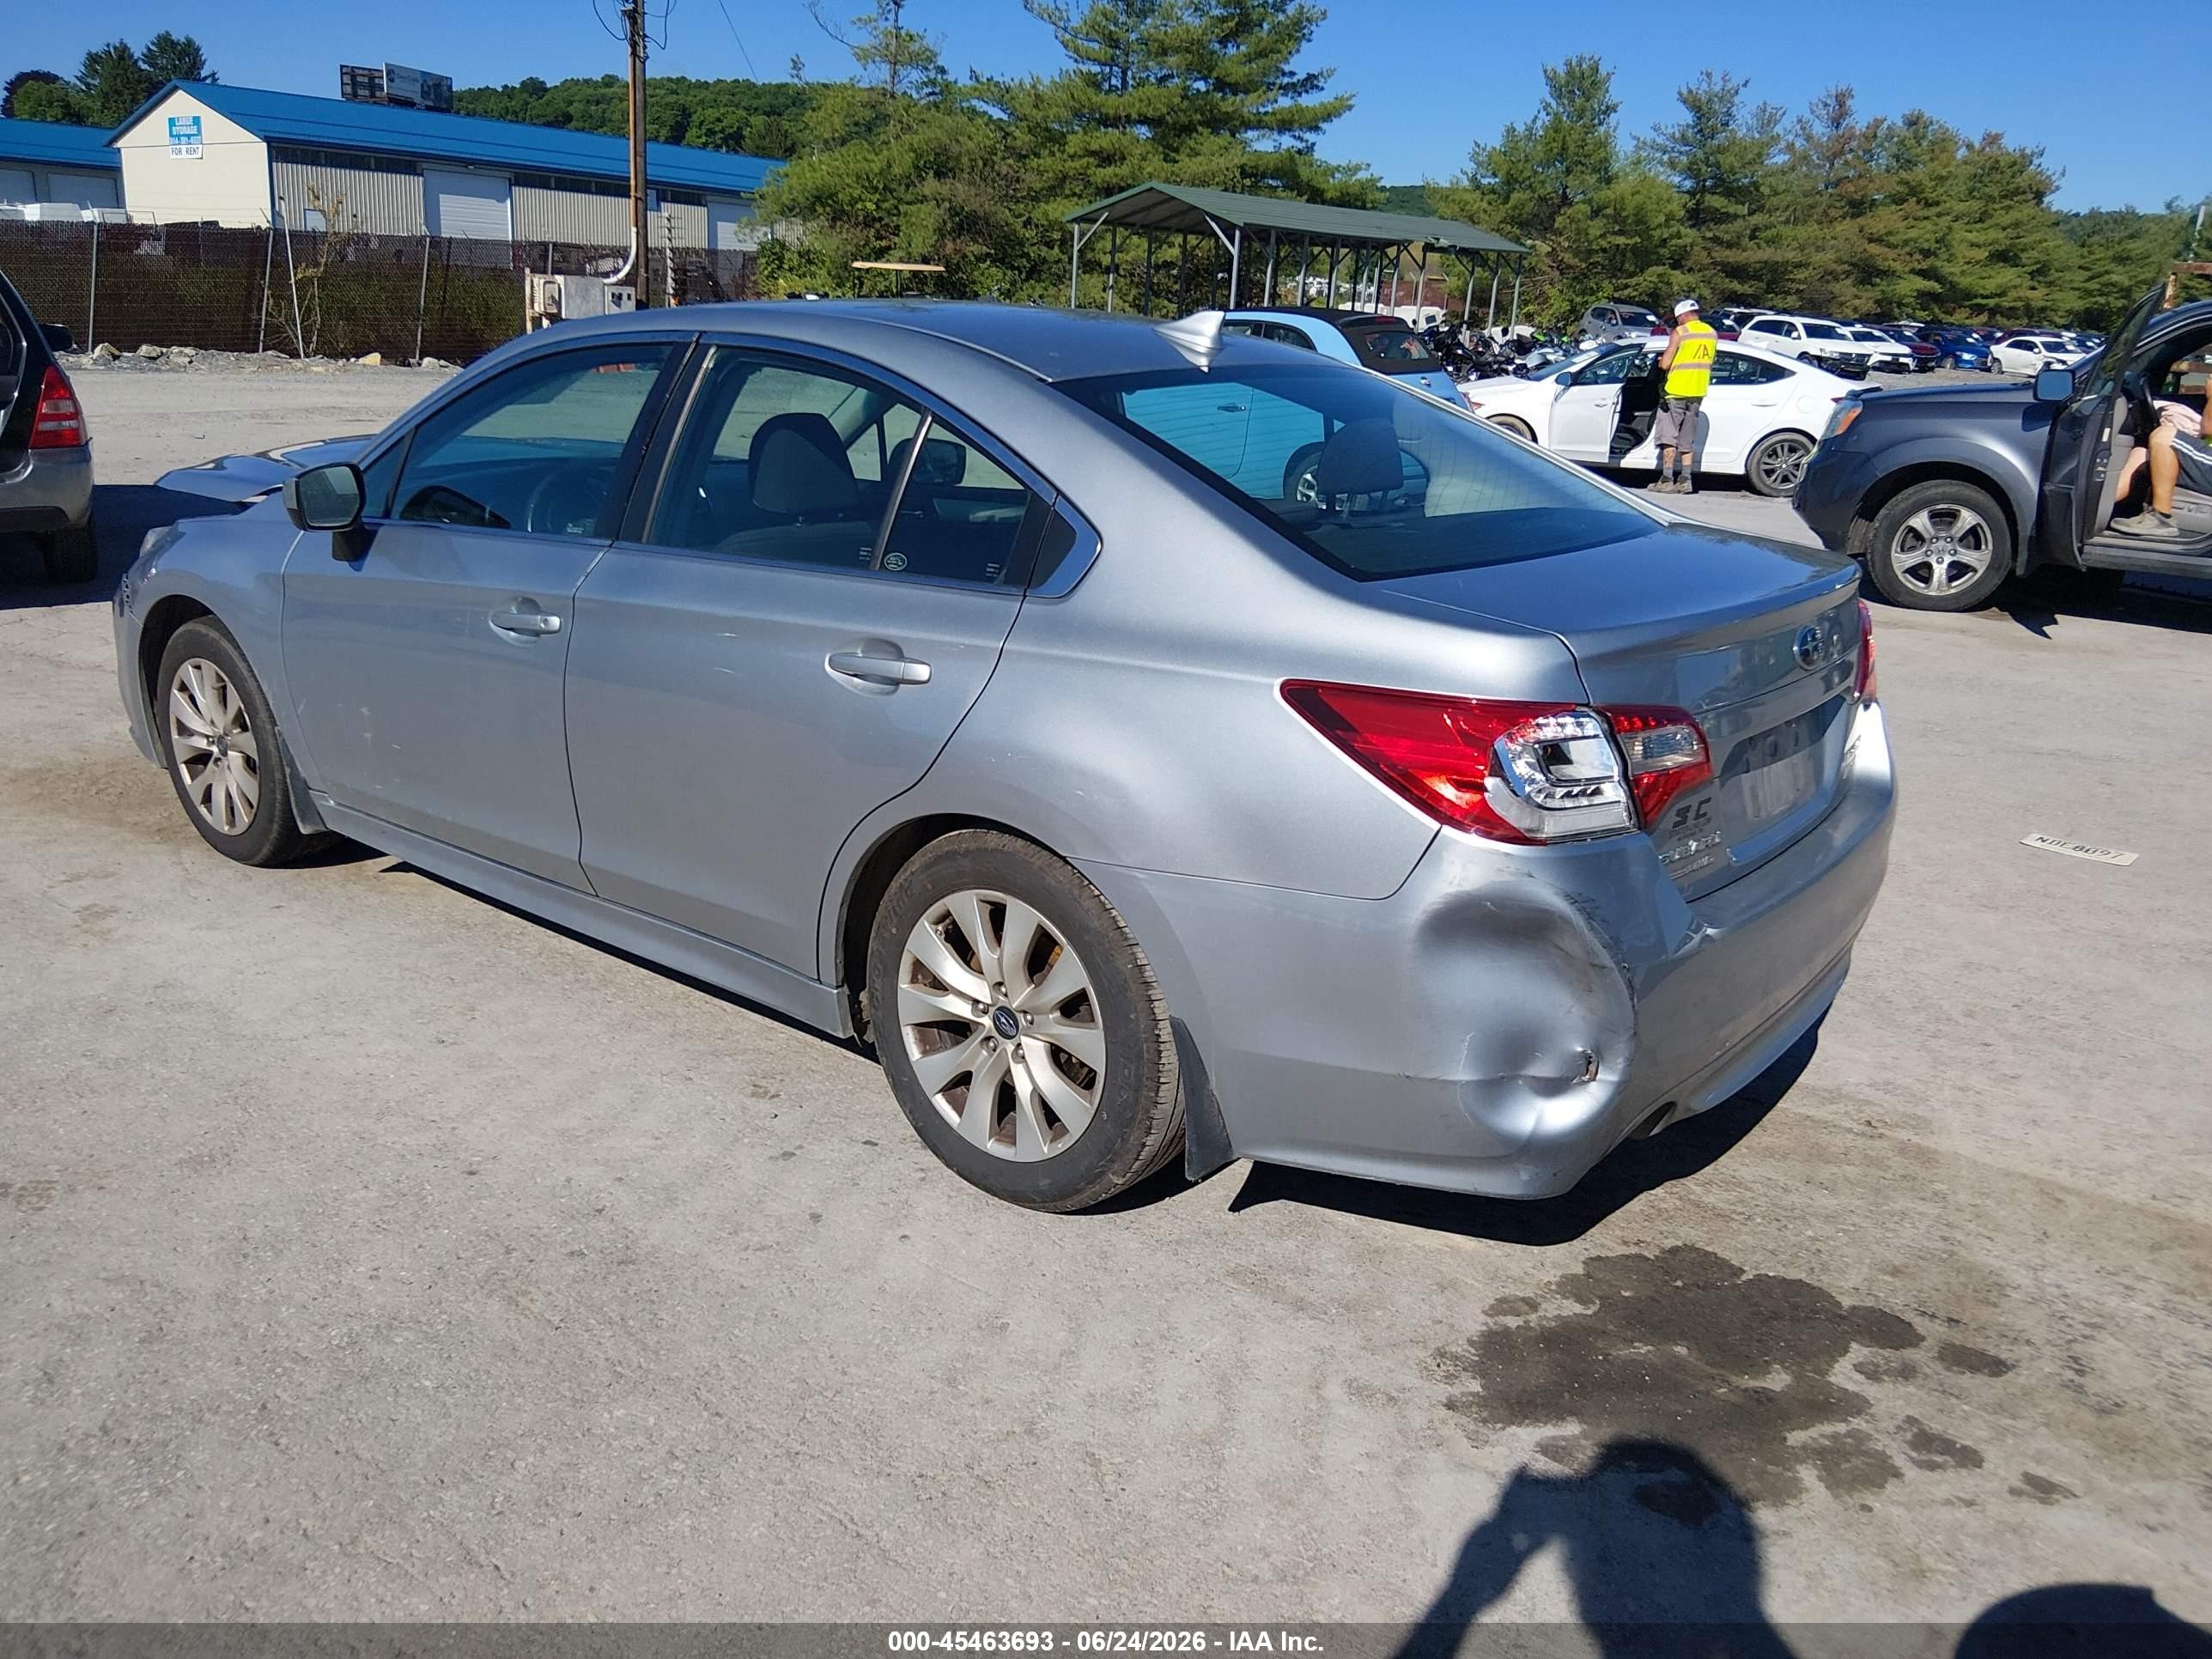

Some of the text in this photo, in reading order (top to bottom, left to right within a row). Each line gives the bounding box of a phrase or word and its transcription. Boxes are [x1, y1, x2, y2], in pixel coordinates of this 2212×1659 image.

[172, 125, 198, 135] STORAGE
[171, 147, 182, 155] FOR
[185, 146, 199, 155] RENT
